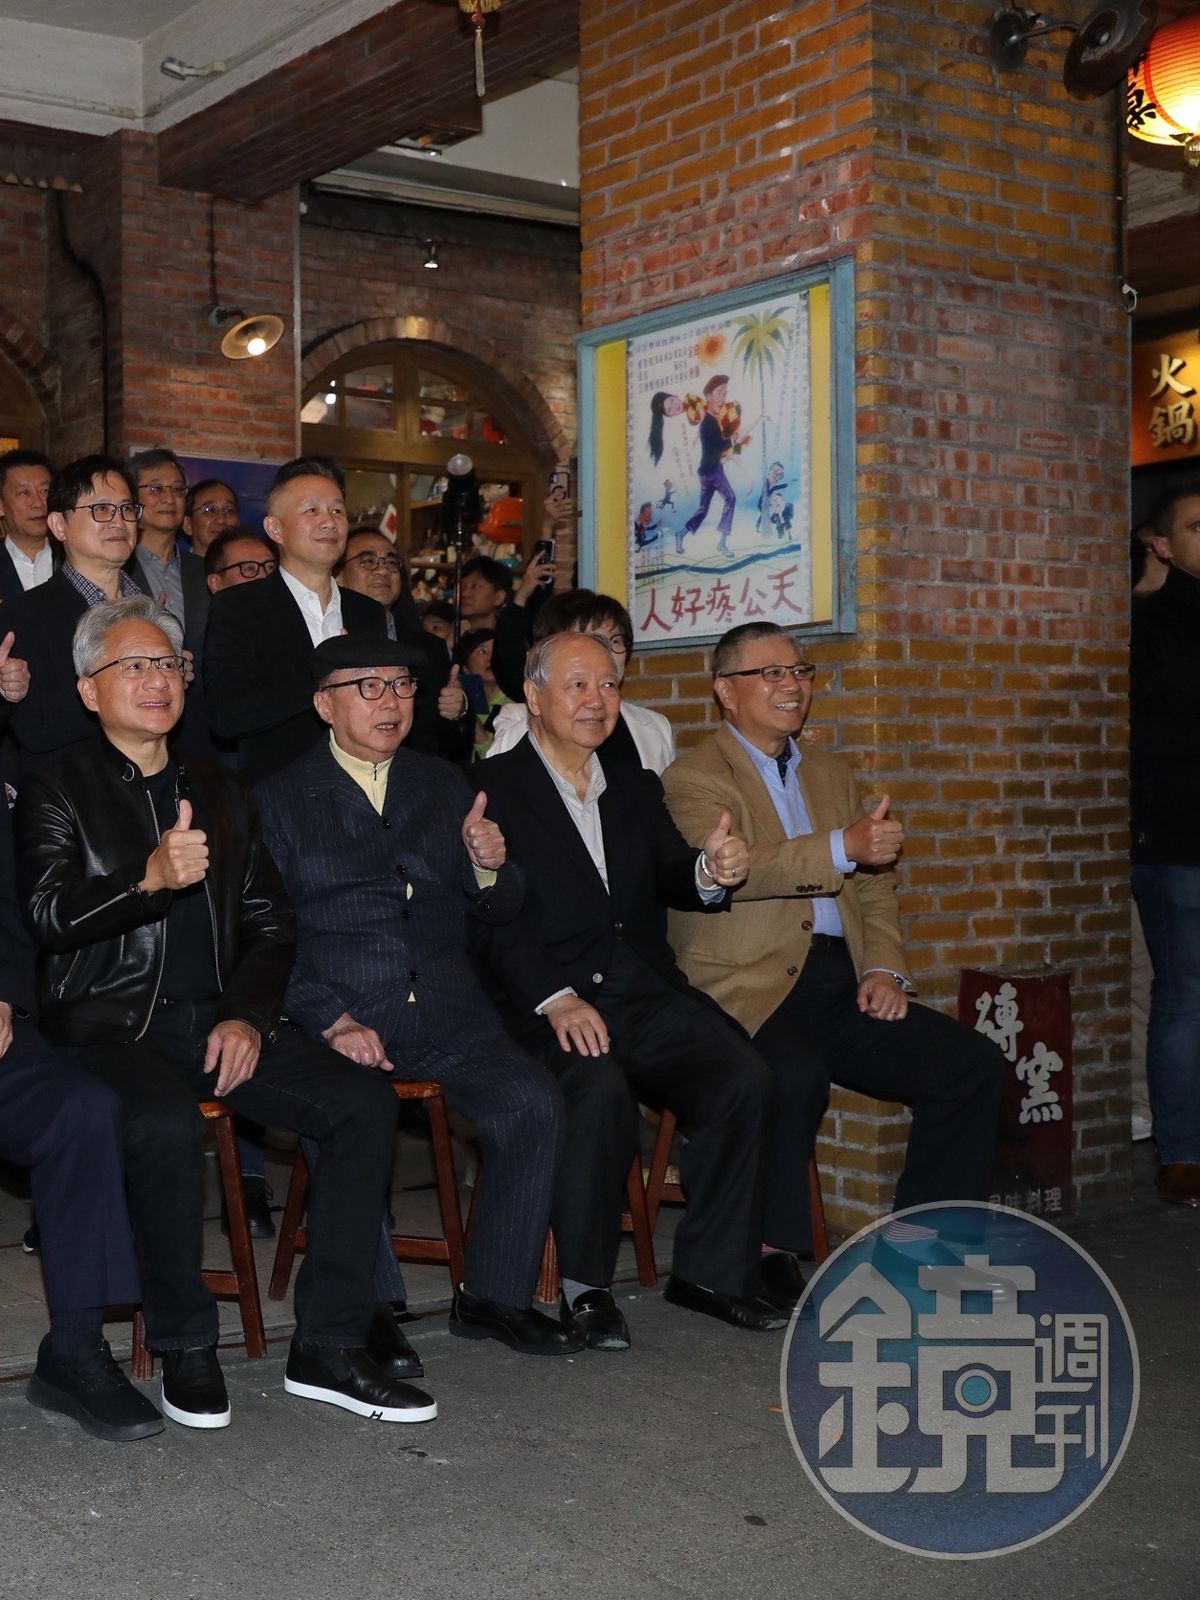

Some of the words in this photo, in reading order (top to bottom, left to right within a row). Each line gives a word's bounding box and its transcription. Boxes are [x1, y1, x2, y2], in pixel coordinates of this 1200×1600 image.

[1149, 353, 1195, 448] 火鍋
[639, 564, 803, 633] 天公疼好人
